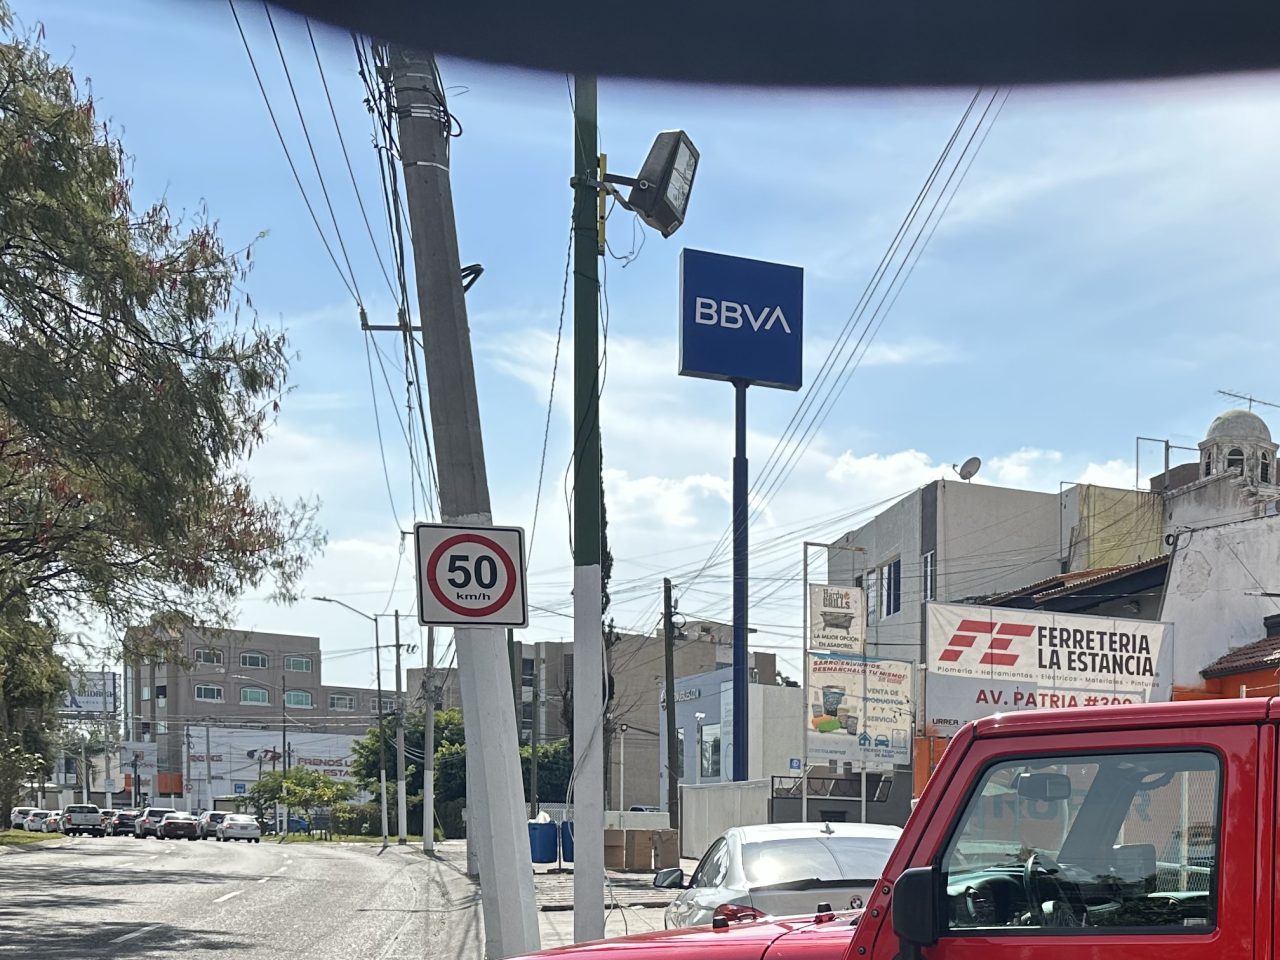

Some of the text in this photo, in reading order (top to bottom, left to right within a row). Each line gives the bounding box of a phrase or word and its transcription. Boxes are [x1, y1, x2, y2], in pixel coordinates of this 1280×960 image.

[695, 297, 792, 334] BBVA
[447, 554, 498, 589] 50
[456, 592, 491, 600] km/h
[1038, 626, 1151, 655] FERRETERIA
[1038, 648, 1154, 677] LA ESTANCIA
[867, 688, 899, 697] VENTA DE
[976, 689, 1008, 706] AV.
[1013, 691, 1079, 708] PATRIA
[298, 758, 343, 767] FRENOS
[324, 769, 352, 777] ESTA
